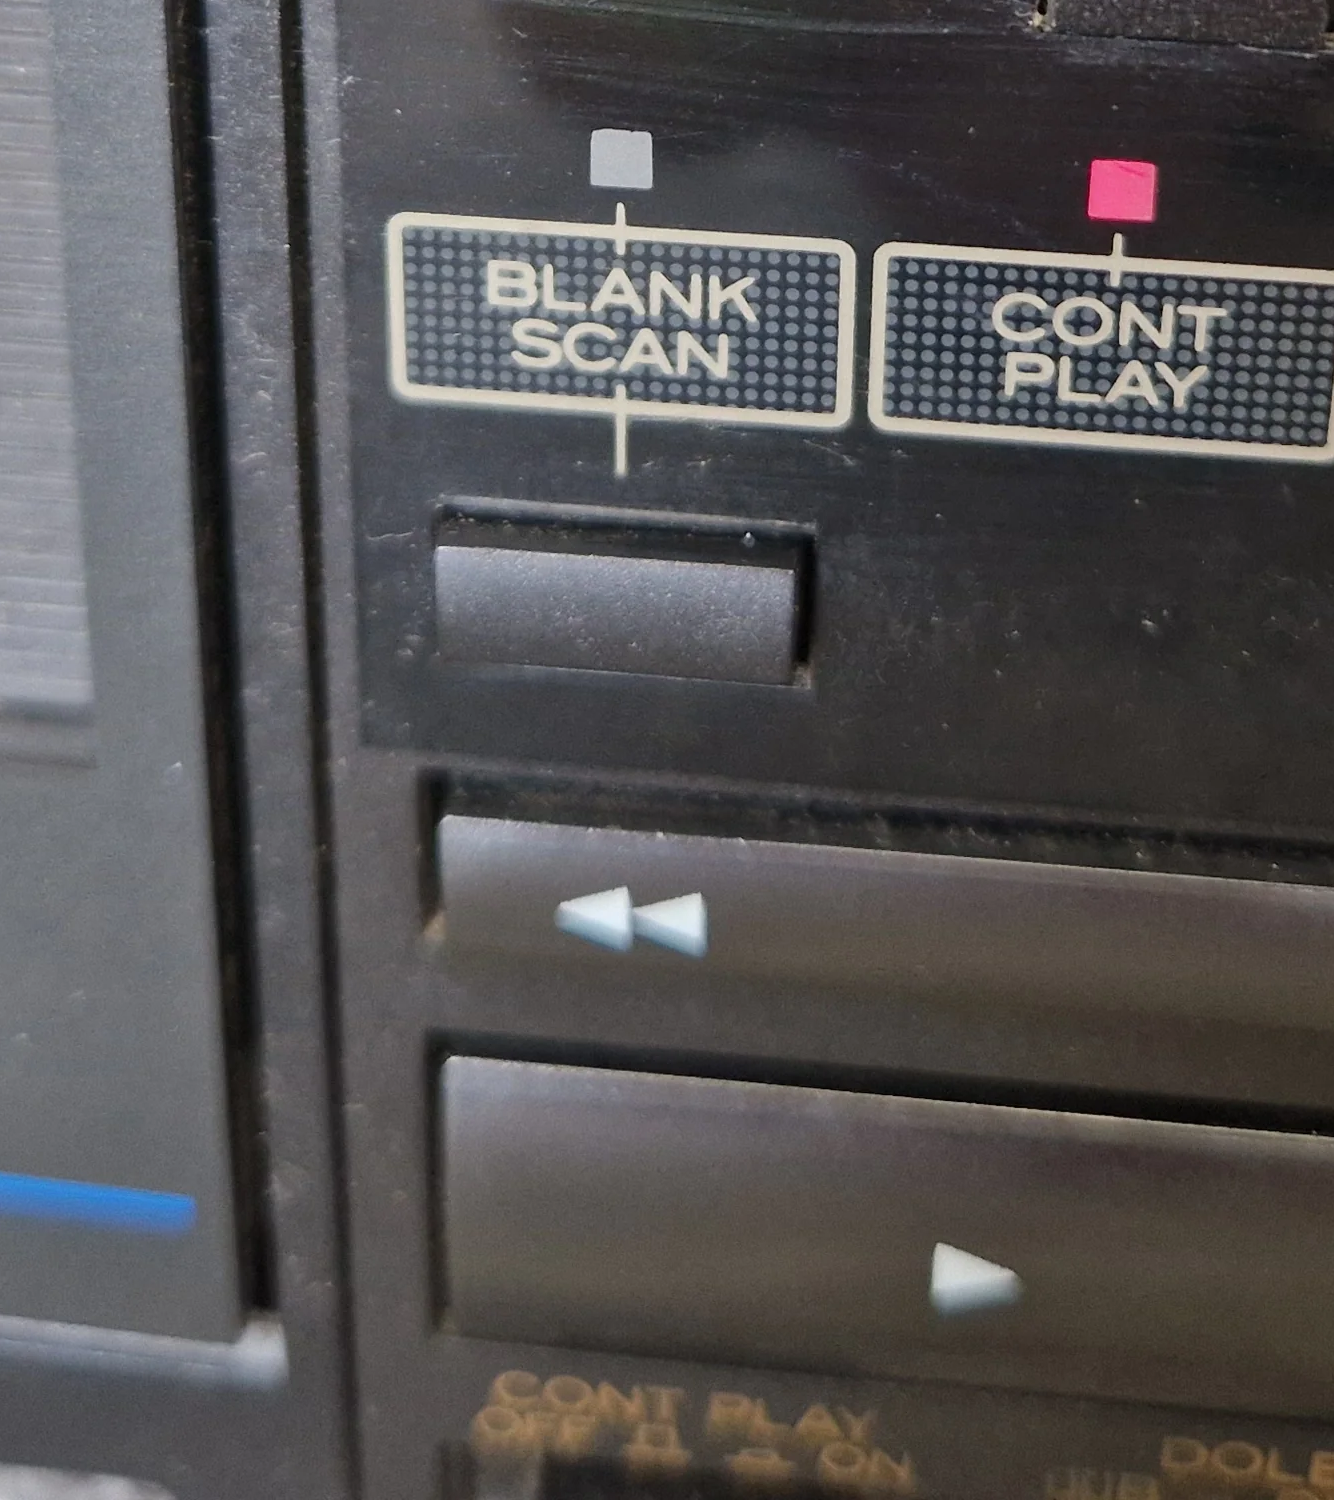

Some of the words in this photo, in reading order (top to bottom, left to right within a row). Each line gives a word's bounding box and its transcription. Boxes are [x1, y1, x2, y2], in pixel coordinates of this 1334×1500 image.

[485, 259, 759, 324] BLANK
[510, 320, 731, 380] SCAN
[990, 293, 1226, 353] CONT
[1004, 351, 1209, 411] PLAY
